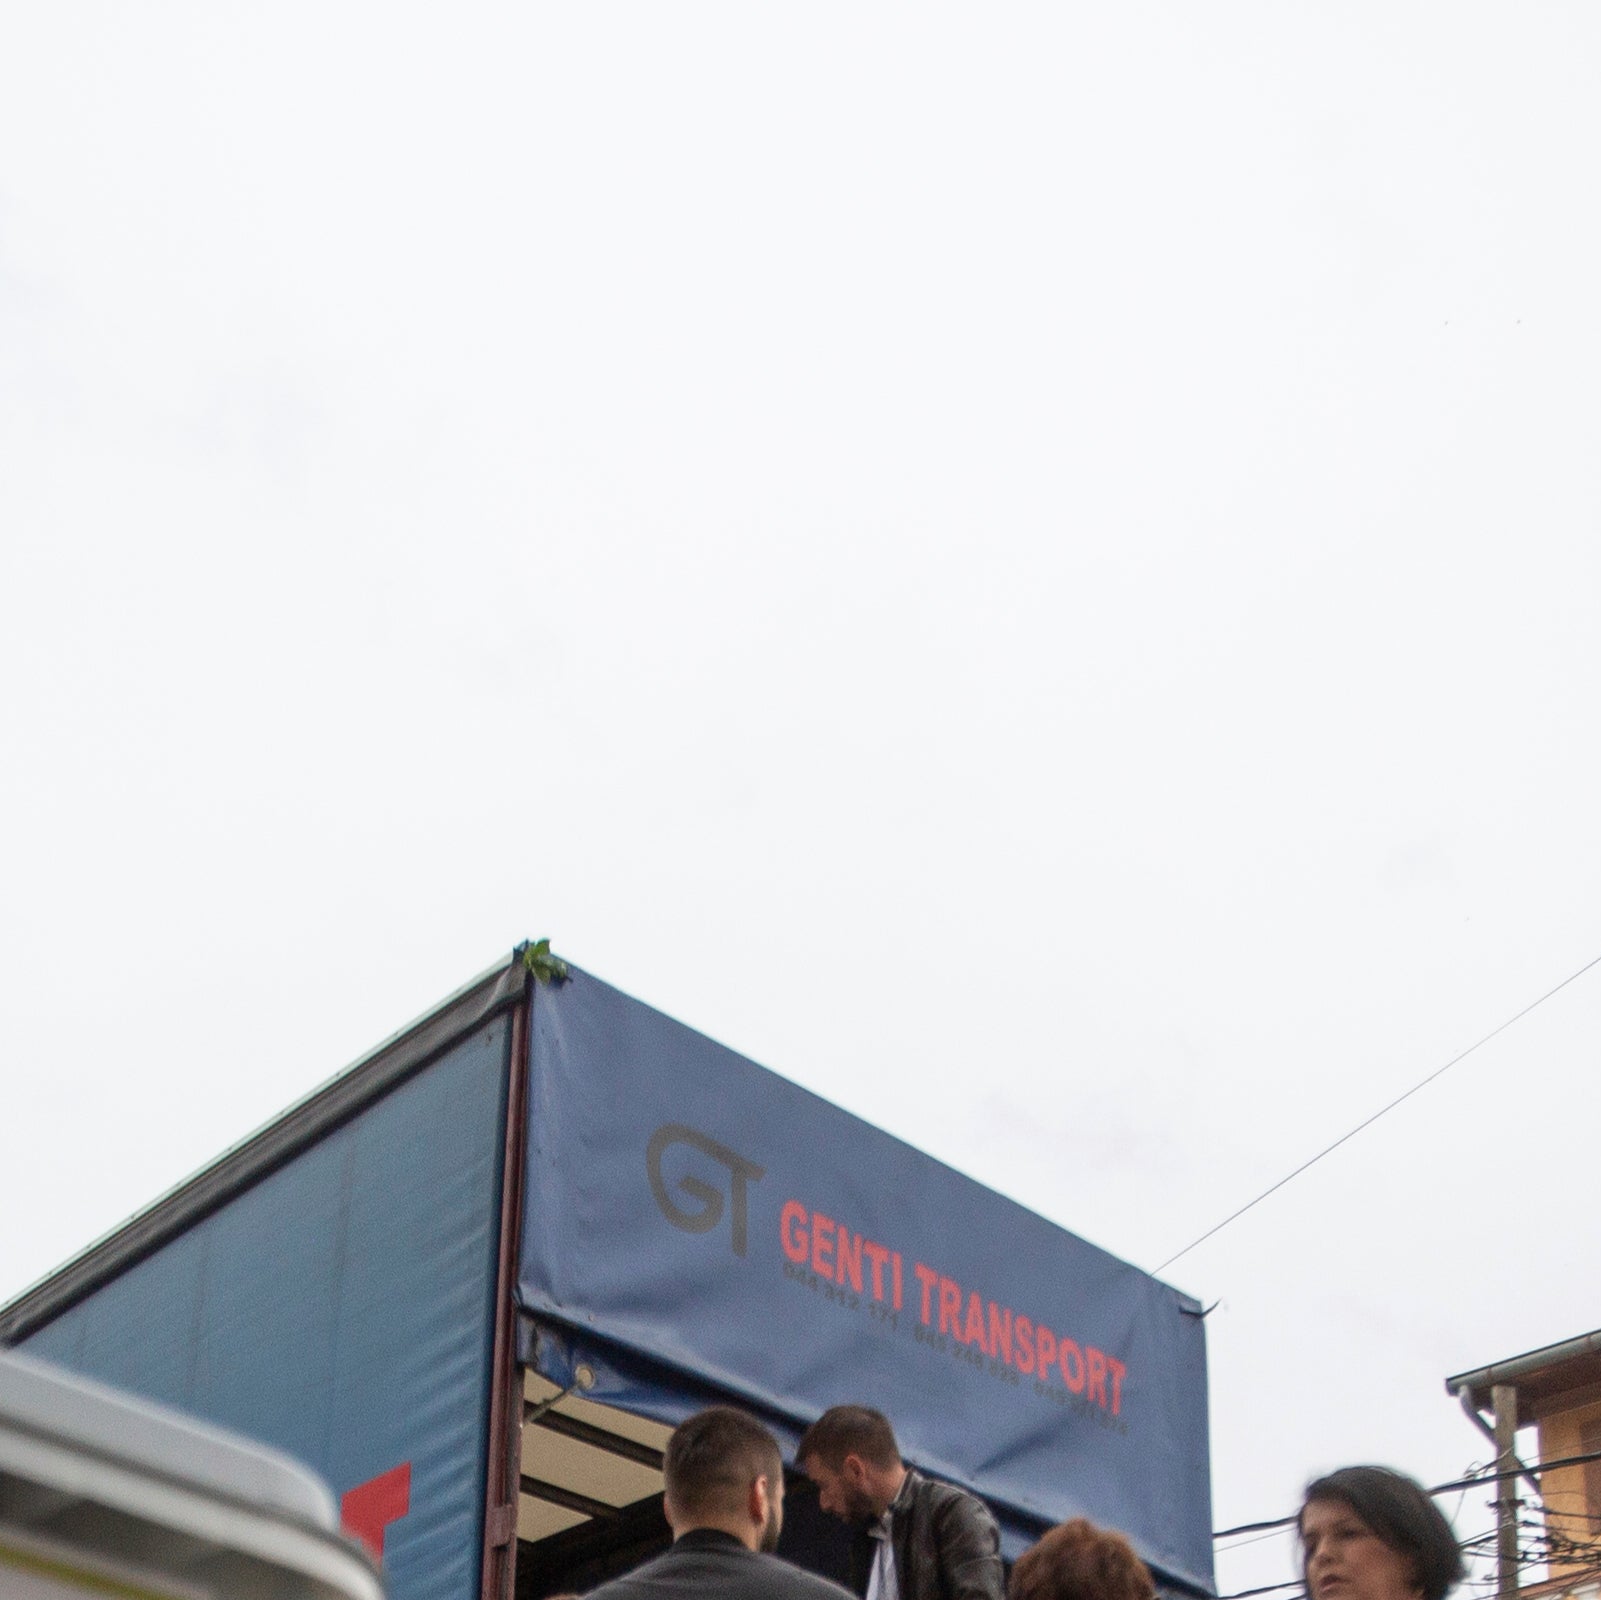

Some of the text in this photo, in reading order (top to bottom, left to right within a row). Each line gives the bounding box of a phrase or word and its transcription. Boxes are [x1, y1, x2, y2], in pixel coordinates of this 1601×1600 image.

[646, 1123, 767, 1259] GT
[779, 1199, 1128, 1416] GENTI TRANSPORT
